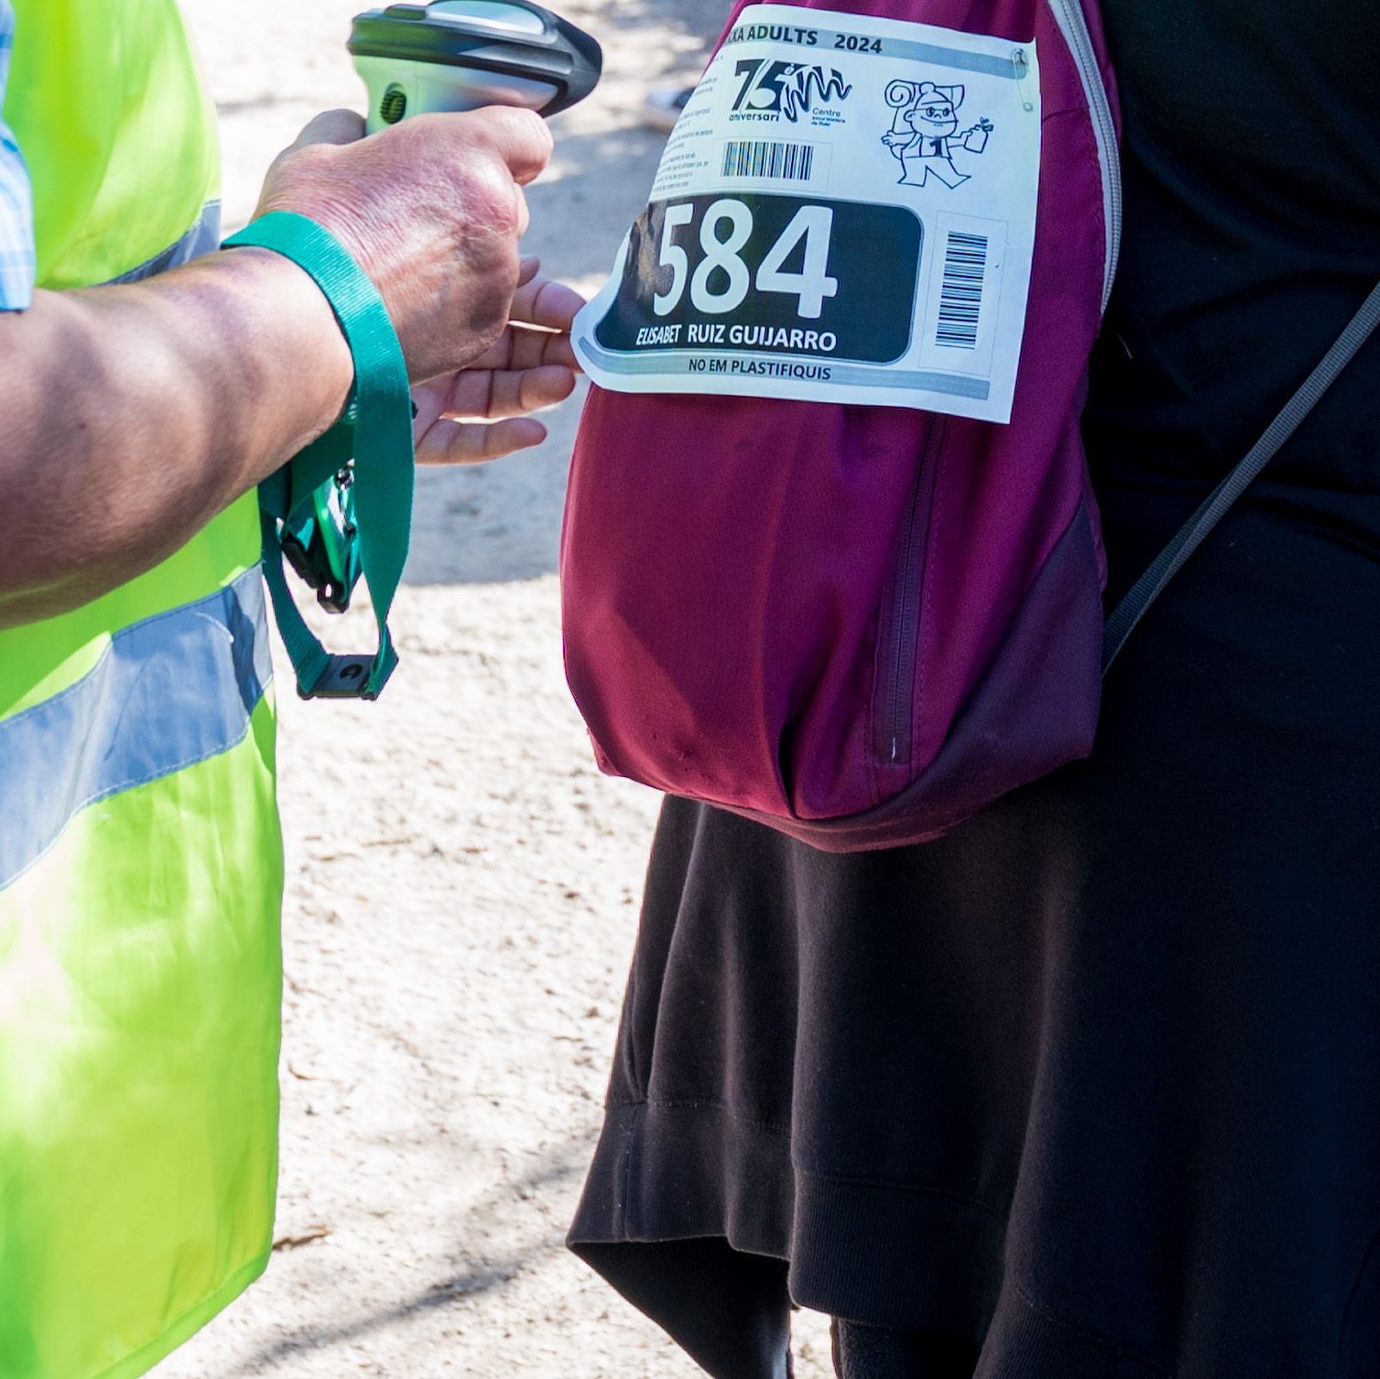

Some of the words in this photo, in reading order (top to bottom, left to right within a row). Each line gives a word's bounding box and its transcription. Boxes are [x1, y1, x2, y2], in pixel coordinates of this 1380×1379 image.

[746, 24, 818, 46] ADULTS
[834, 34, 882, 54] 2024
[729, 111, 780, 123] aniversari
[812, 107, 841, 118] Centre
[653, 198, 839, 319] 584
[636, 324, 682, 346] ELISABET
[687, 323, 725, 344] RUIZ
[729, 324, 837, 352] GUIJARRO
[689, 358, 706, 372] NO
[709, 358, 727, 373] EM
[731, 360, 832, 381] PLASTIFIQUIS
